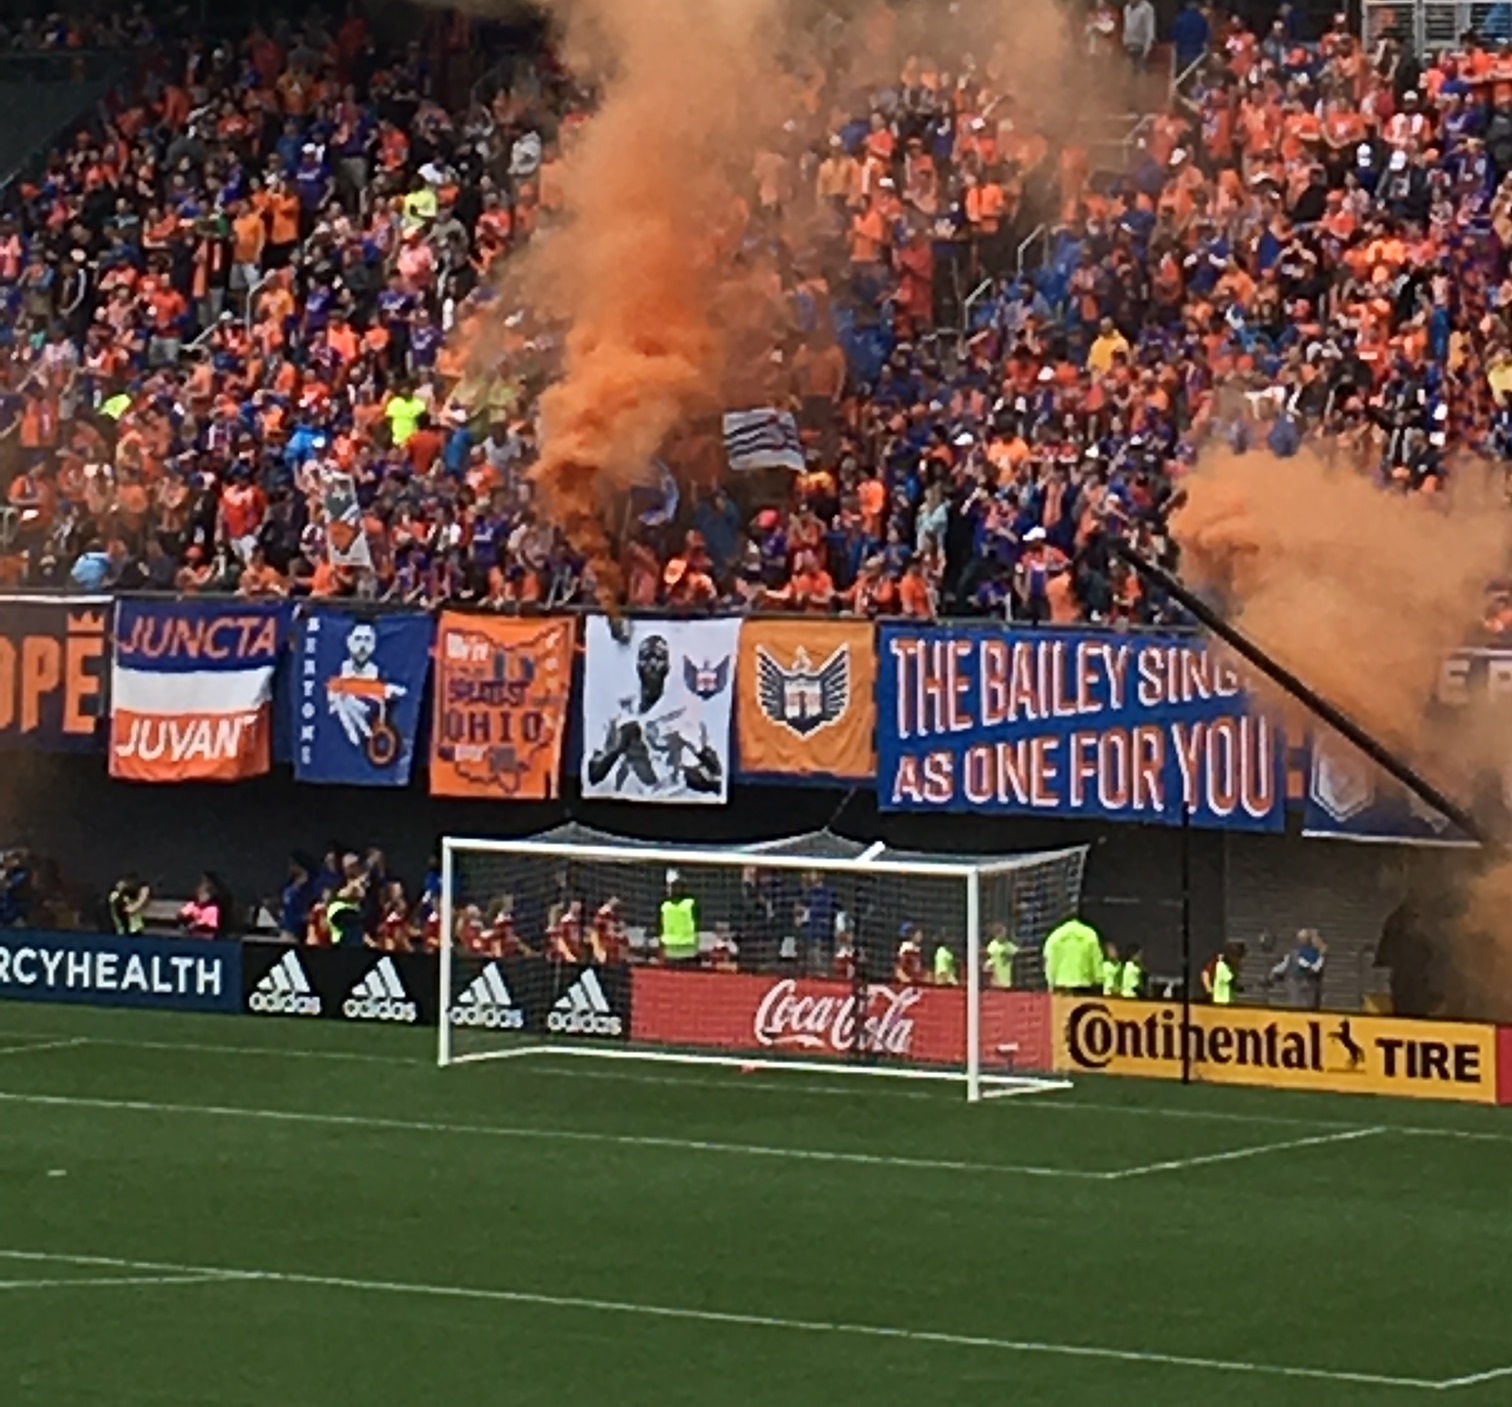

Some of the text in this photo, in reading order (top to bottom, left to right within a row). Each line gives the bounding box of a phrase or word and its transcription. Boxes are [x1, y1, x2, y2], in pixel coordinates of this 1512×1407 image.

[118, 616, 278, 659] JUNCTA
[890, 637, 1248, 739] THE BAILEY SING
[443, 709, 545, 743] OHIO
[891, 714, 1276, 818] AS ONE FOR YOU
[249, 990, 321, 1015] adidas
[342, 996, 417, 1022] adidas
[450, 1004, 524, 1029] adidas
[547, 1009, 622, 1035] adidas
[1066, 1003, 1481, 1083] Continental TIRE
